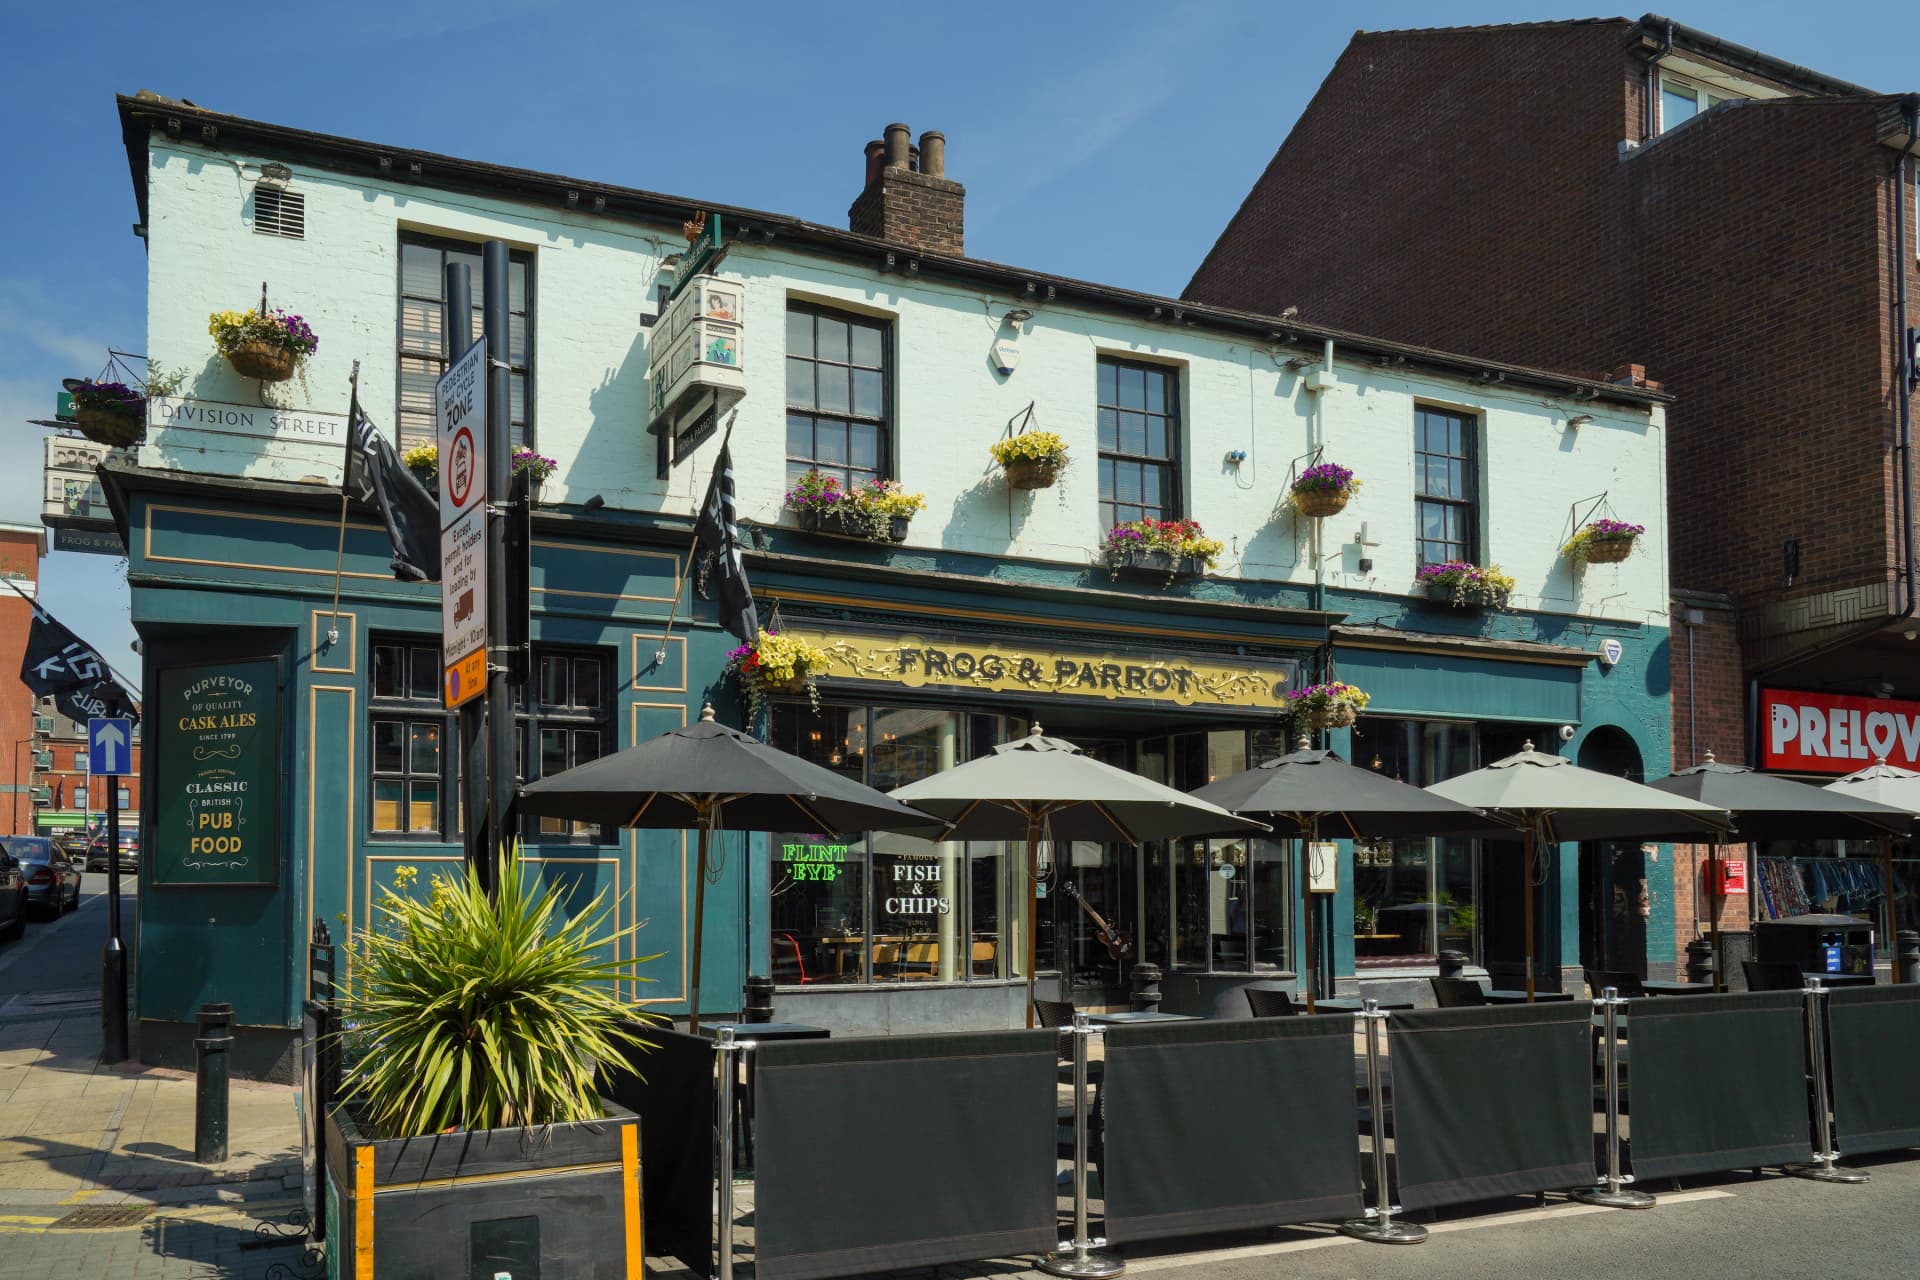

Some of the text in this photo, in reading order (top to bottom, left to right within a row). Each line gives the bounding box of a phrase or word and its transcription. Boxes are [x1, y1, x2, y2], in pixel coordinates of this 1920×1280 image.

[442, 350, 479, 397] PEDESTRIAN
[444, 370, 475, 410] and CYCLE
[161, 404, 338, 436] DIVISION STREET
[446, 390, 473, 432] ZONE
[61, 535, 90, 546] FROG
[453, 519, 471, 543] Except
[444, 529, 481, 568] permit holders
[453, 557, 462, 576] and
[449, 567, 476, 595] loading by
[445, 635, 465, 660] Midnight
[897, 647, 1194, 696] FROG & PARROT
[183, 676, 253, 701] PURVEYOR
[192, 700, 243, 712] OF QUALITY
[179, 712, 257, 731] CASK ALES
[186, 781, 248, 794] CLASSIC
[201, 798, 231, 807] BRITISH
[199, 812, 233, 829] PUB
[191, 836, 242, 854] FOOD
[782, 844, 848, 862] FLINT
[793, 863, 836, 881] EYE
[893, 865, 942, 881] FISH
[912, 882, 924, 895] &
[885, 897, 950, 915] CHIPS
